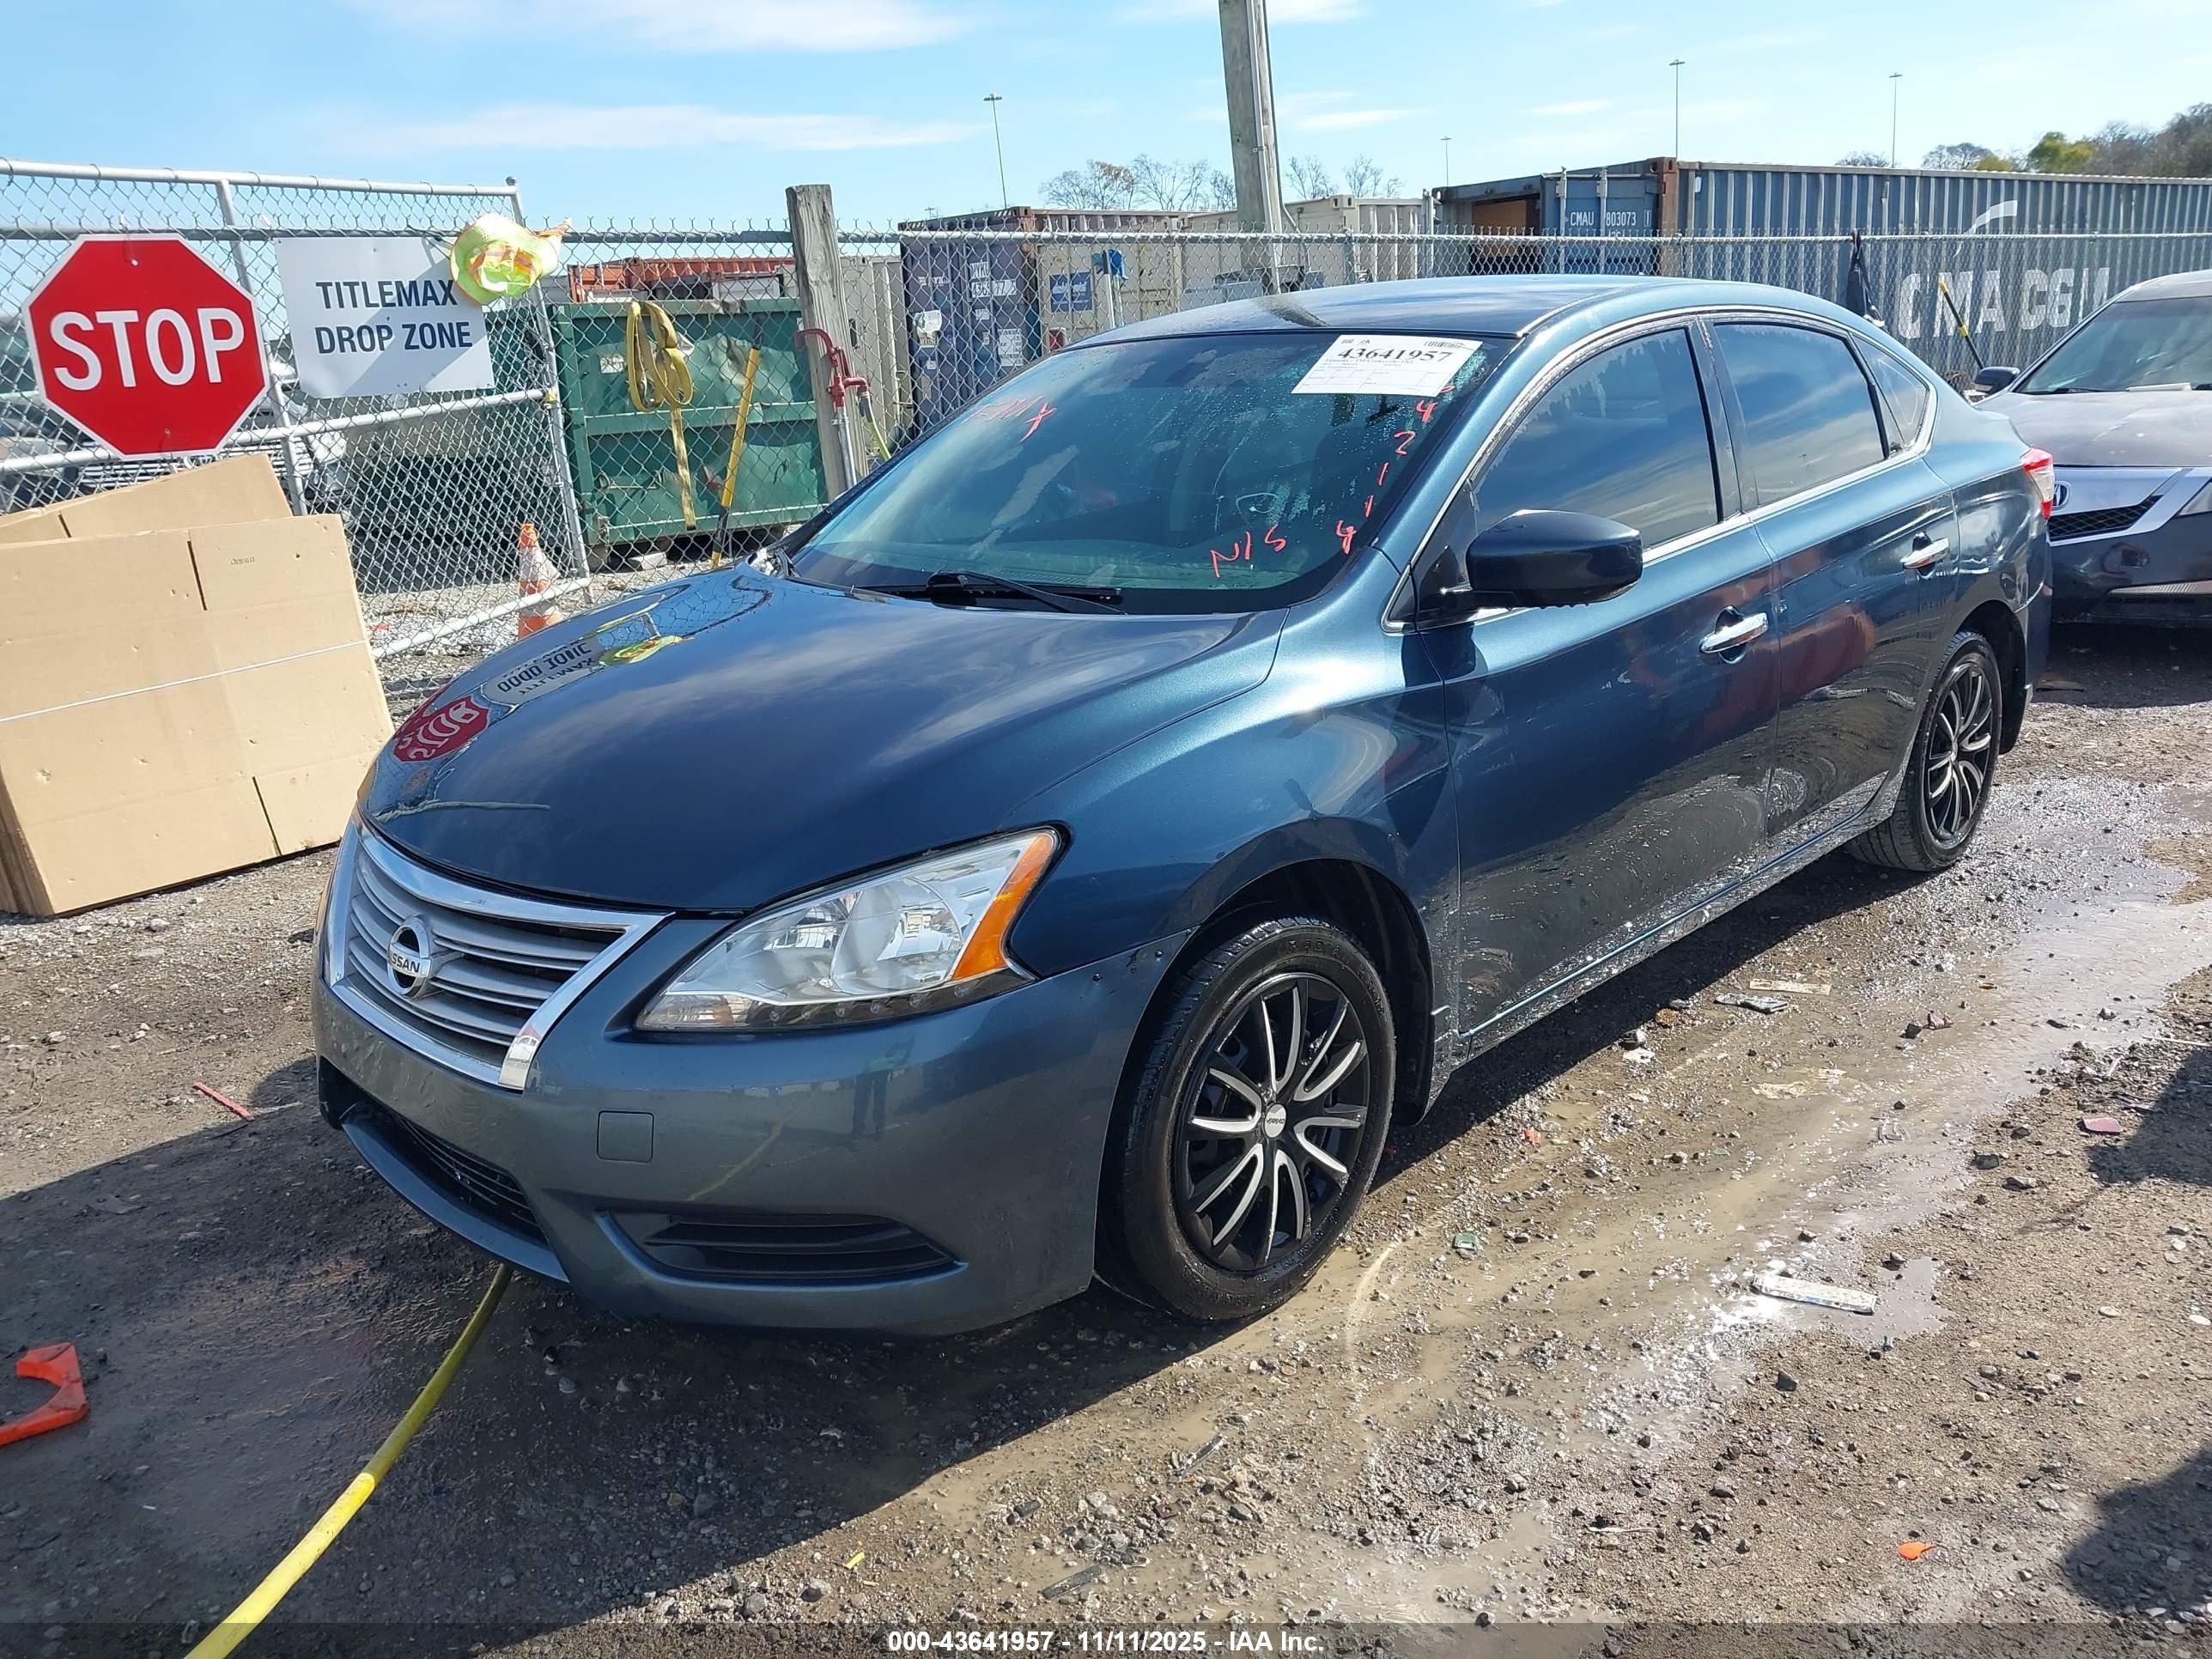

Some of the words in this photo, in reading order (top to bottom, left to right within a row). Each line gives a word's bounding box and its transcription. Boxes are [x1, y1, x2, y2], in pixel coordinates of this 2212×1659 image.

[1570, 210, 1595, 227] CMAU
[1606, 211, 1637, 227] 803073
[315, 280, 458, 309] TITLEMAX
[50, 307, 246, 391] STOP
[315, 325, 393, 354] DROP
[402, 322, 473, 350] ZONE
[1337, 348, 1453, 362] 43641957
